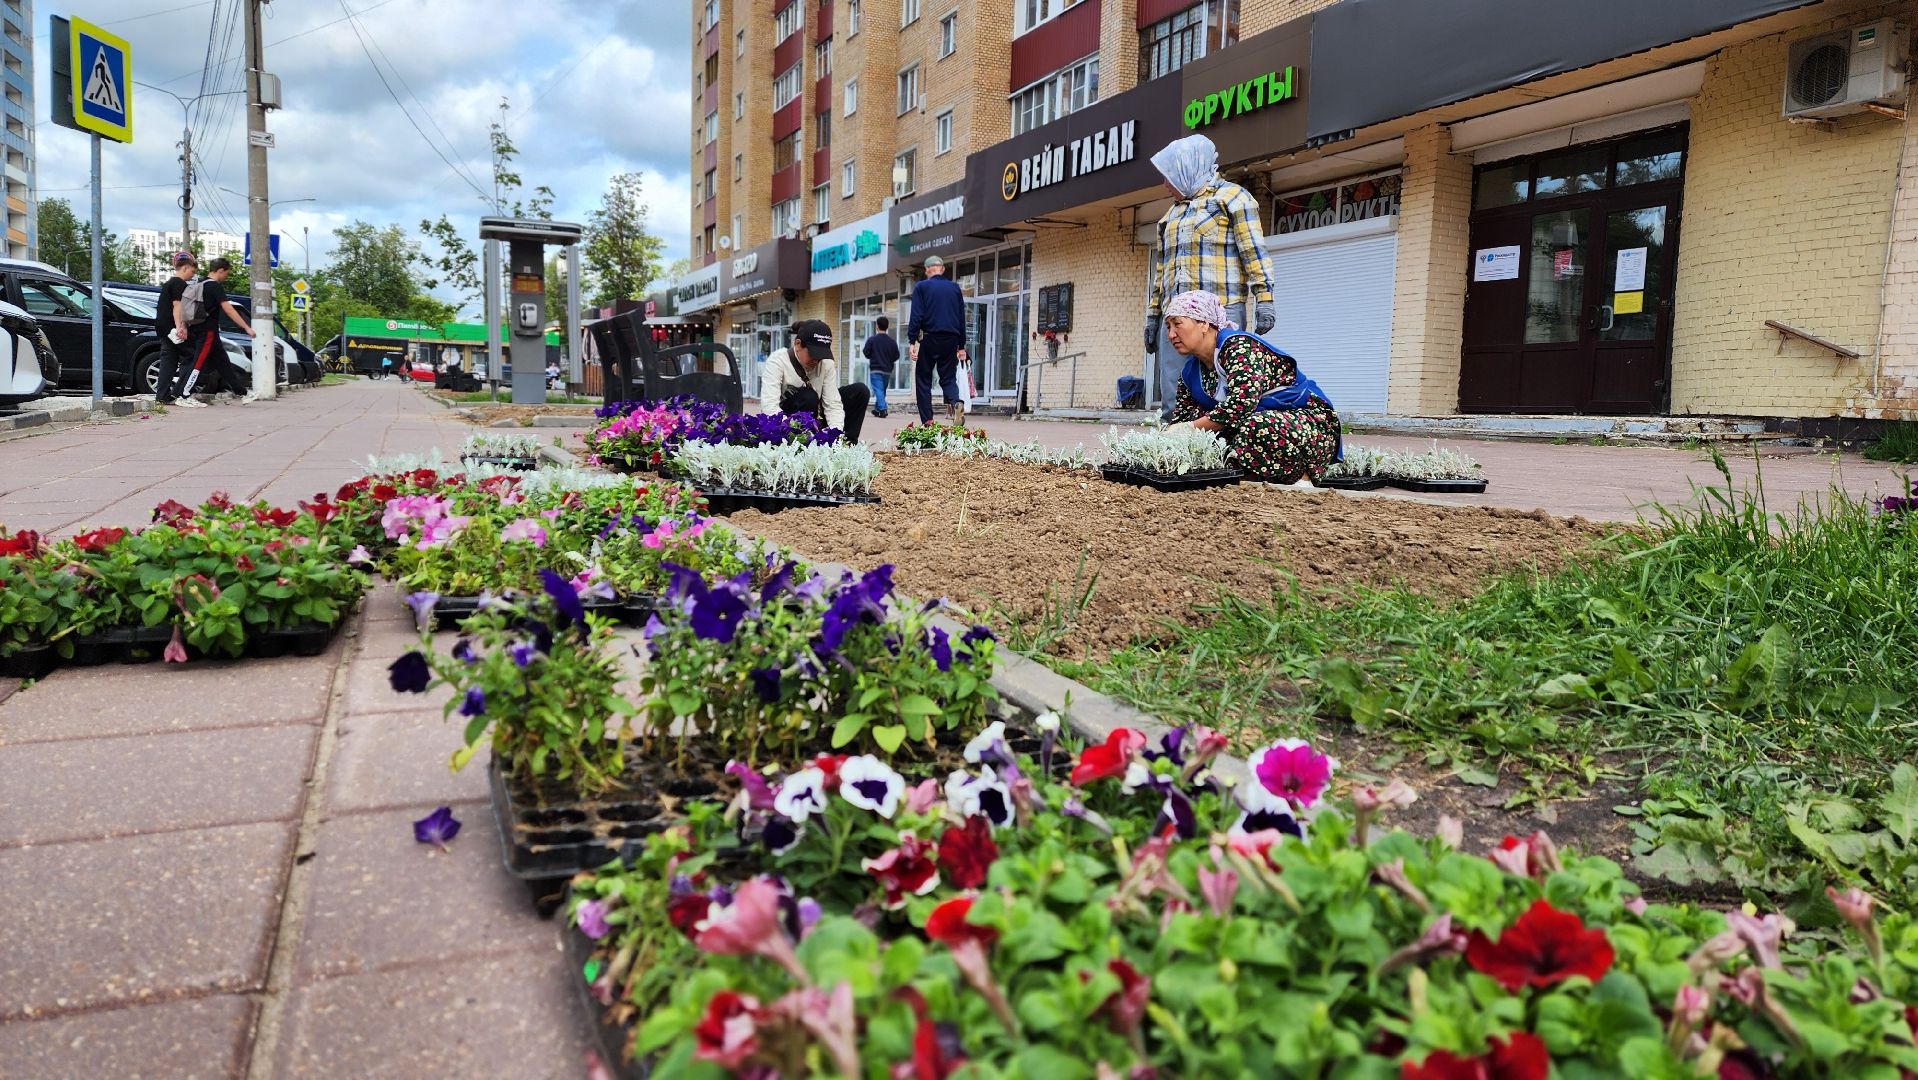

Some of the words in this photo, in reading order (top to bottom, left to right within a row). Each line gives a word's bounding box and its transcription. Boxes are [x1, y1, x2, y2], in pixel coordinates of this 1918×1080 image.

[1183, 66, 1295, 129] ФРУКТЫ
[1020, 143, 1065, 193] ВЕЙП
[1070, 120, 1136, 178] ТАБАК
[812, 243, 850, 273] АПТЕКА
[932, 235, 953, 247] ОДЕЖДА
